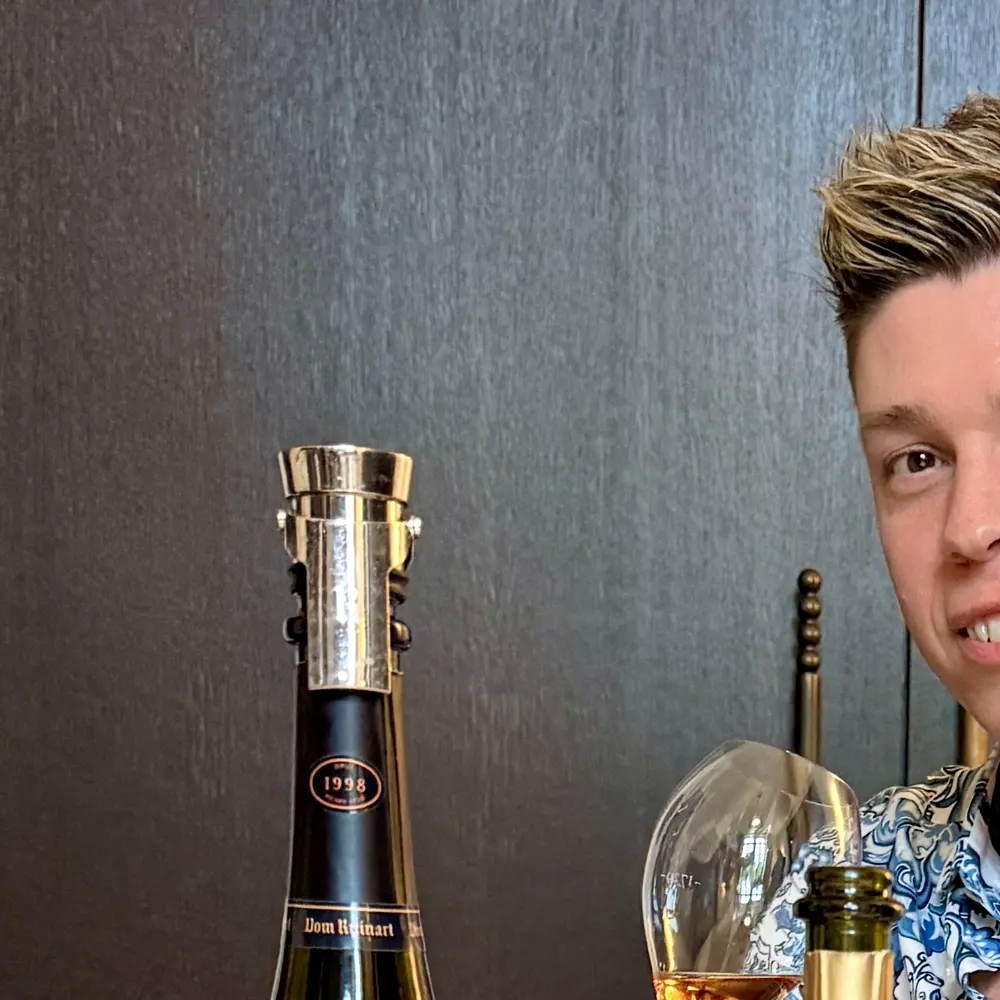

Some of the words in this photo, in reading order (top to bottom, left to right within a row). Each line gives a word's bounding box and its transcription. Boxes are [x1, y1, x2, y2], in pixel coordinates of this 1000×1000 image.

[324, 775, 367, 793] 1998
[303, 917, 335, 934] Dom
[337, 918, 395, 937] Ruinart
